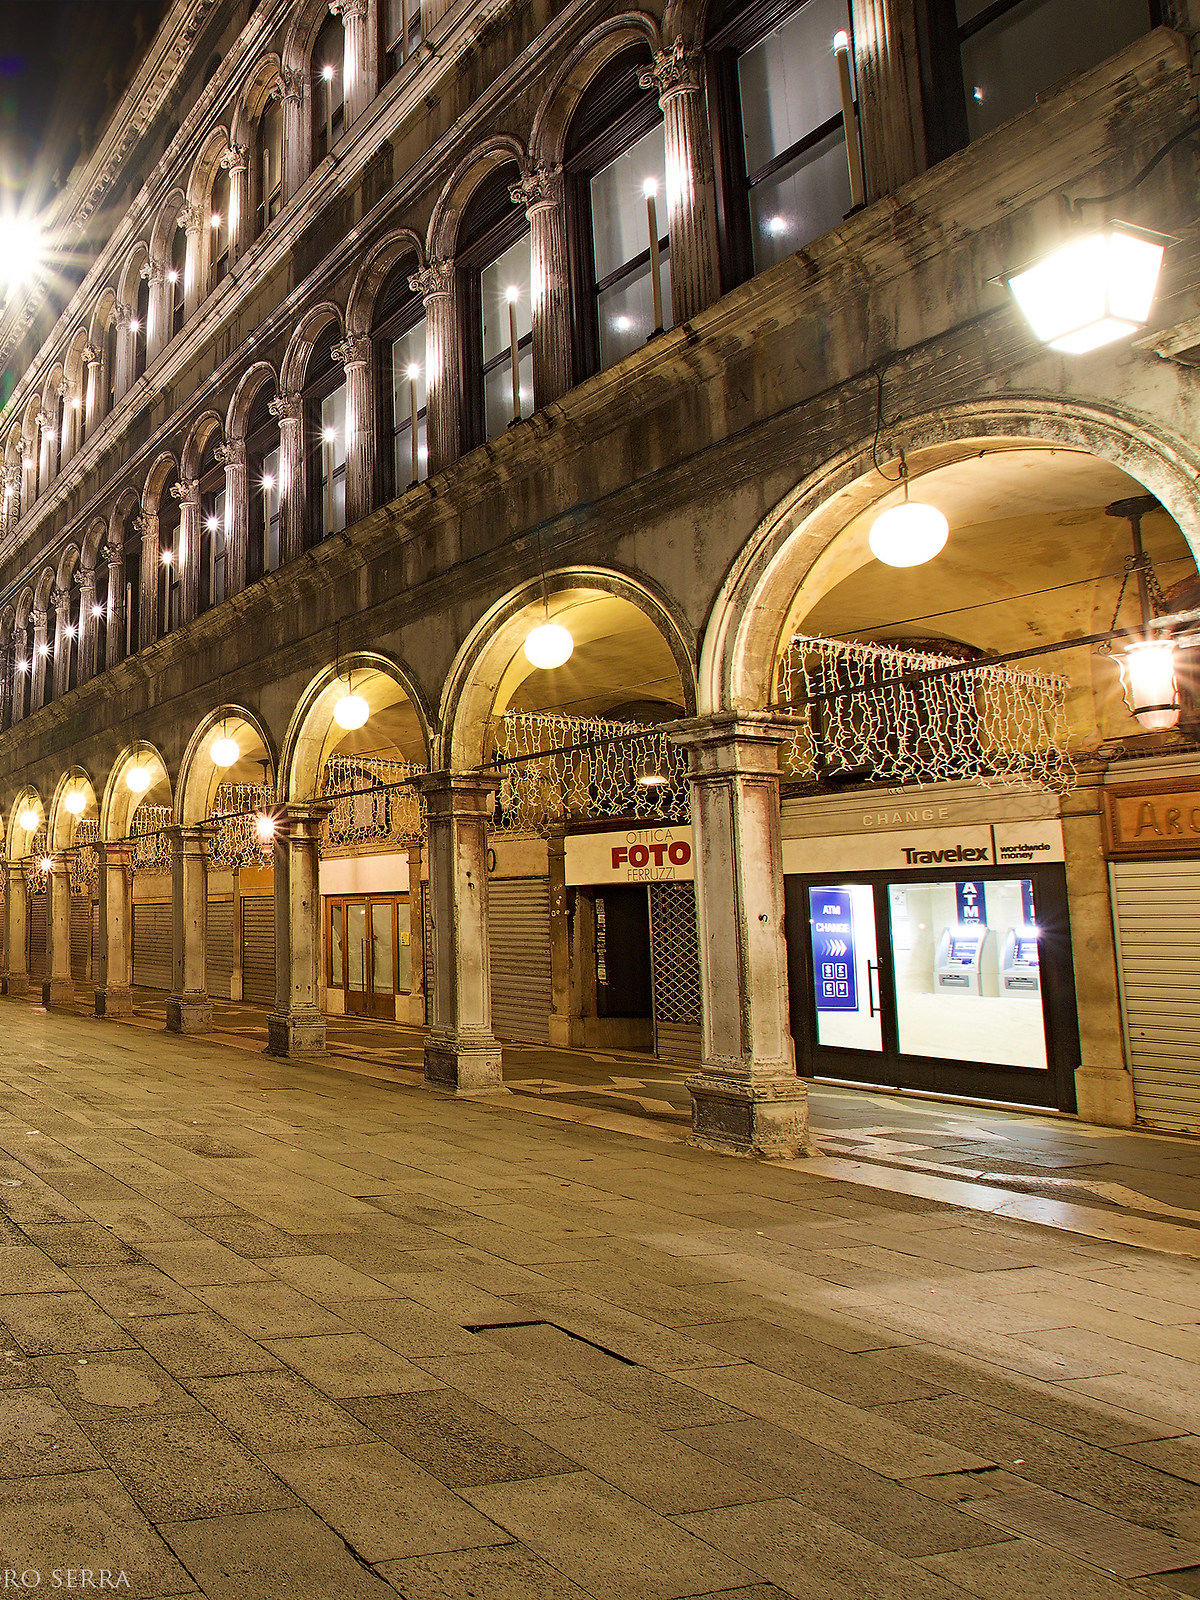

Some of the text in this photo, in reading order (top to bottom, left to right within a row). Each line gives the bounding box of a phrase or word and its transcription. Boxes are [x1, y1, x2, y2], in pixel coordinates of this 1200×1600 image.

[862, 807, 950, 827] CHANGE
[626, 829, 673, 844] OTTICA
[611, 841, 692, 869] FOTO
[901, 844, 990, 865] Travelex
[1000, 842, 1052, 854] worldwide
[1000, 851, 1034, 861] money
[627, 867, 675, 881] FERRUZZI
[962, 882, 980, 918] ATM
[822, 904, 842, 915] ATM
[815, 922, 850, 933] CHANGE
